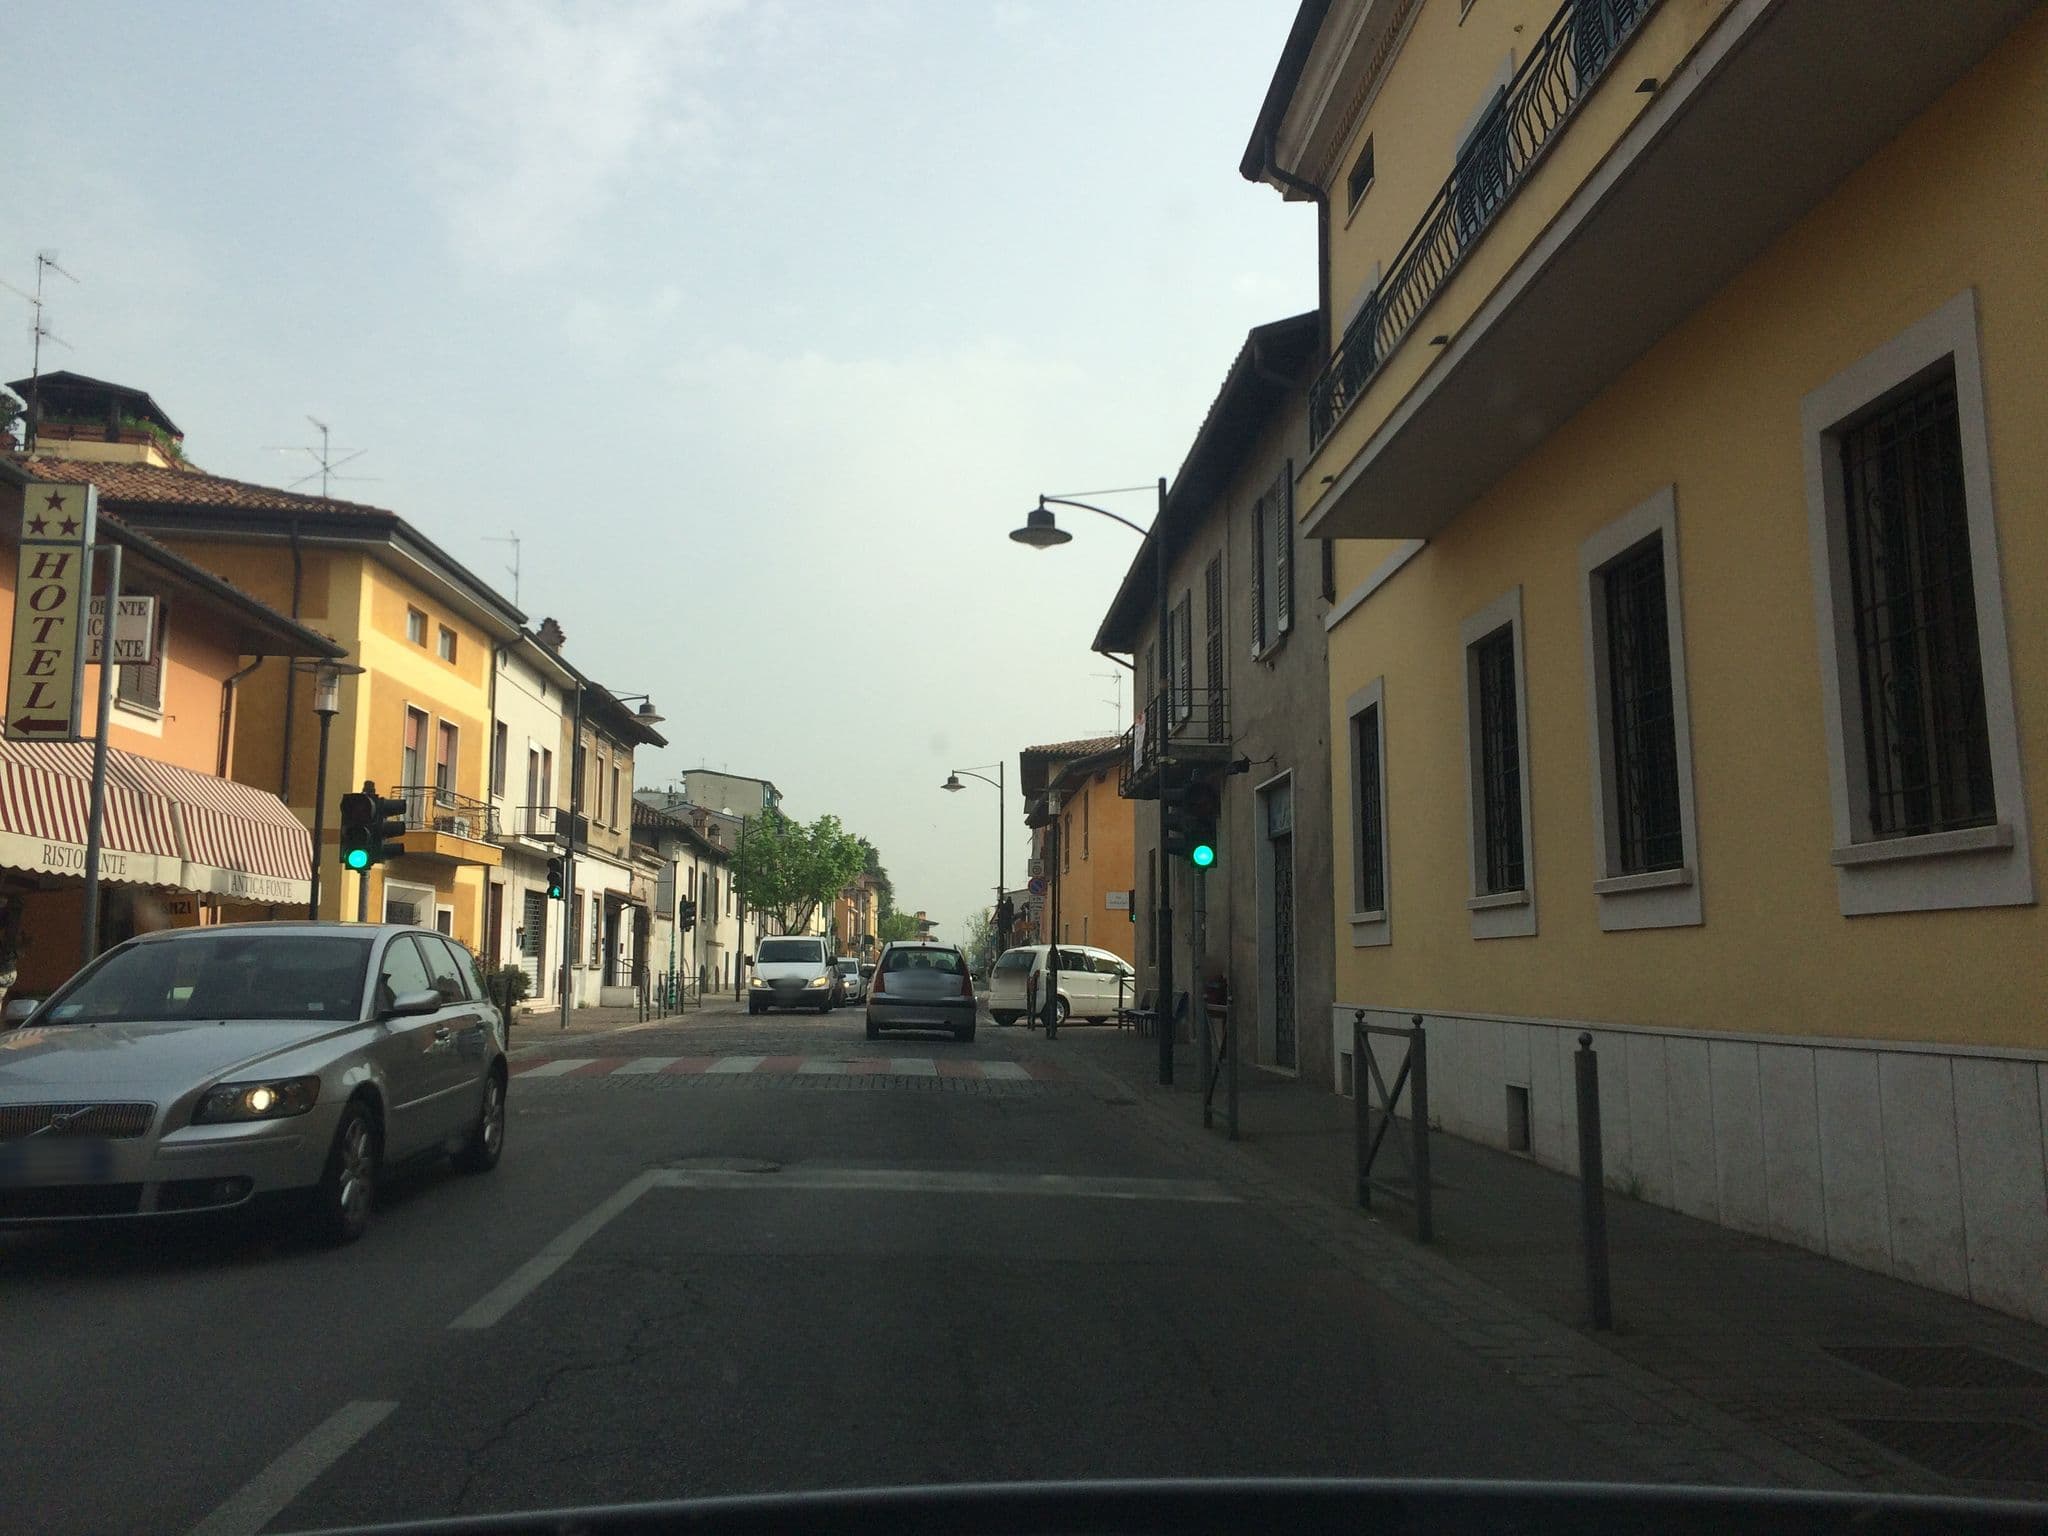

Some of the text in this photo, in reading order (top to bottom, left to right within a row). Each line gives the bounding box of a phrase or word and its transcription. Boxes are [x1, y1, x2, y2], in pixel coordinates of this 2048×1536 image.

[23, 552, 73, 709] HOTEL
[92, 639, 144, 657] FNTE
[42, 844, 127, 875] RISTONTE
[231, 874, 293, 898] ANTICA FONTE
